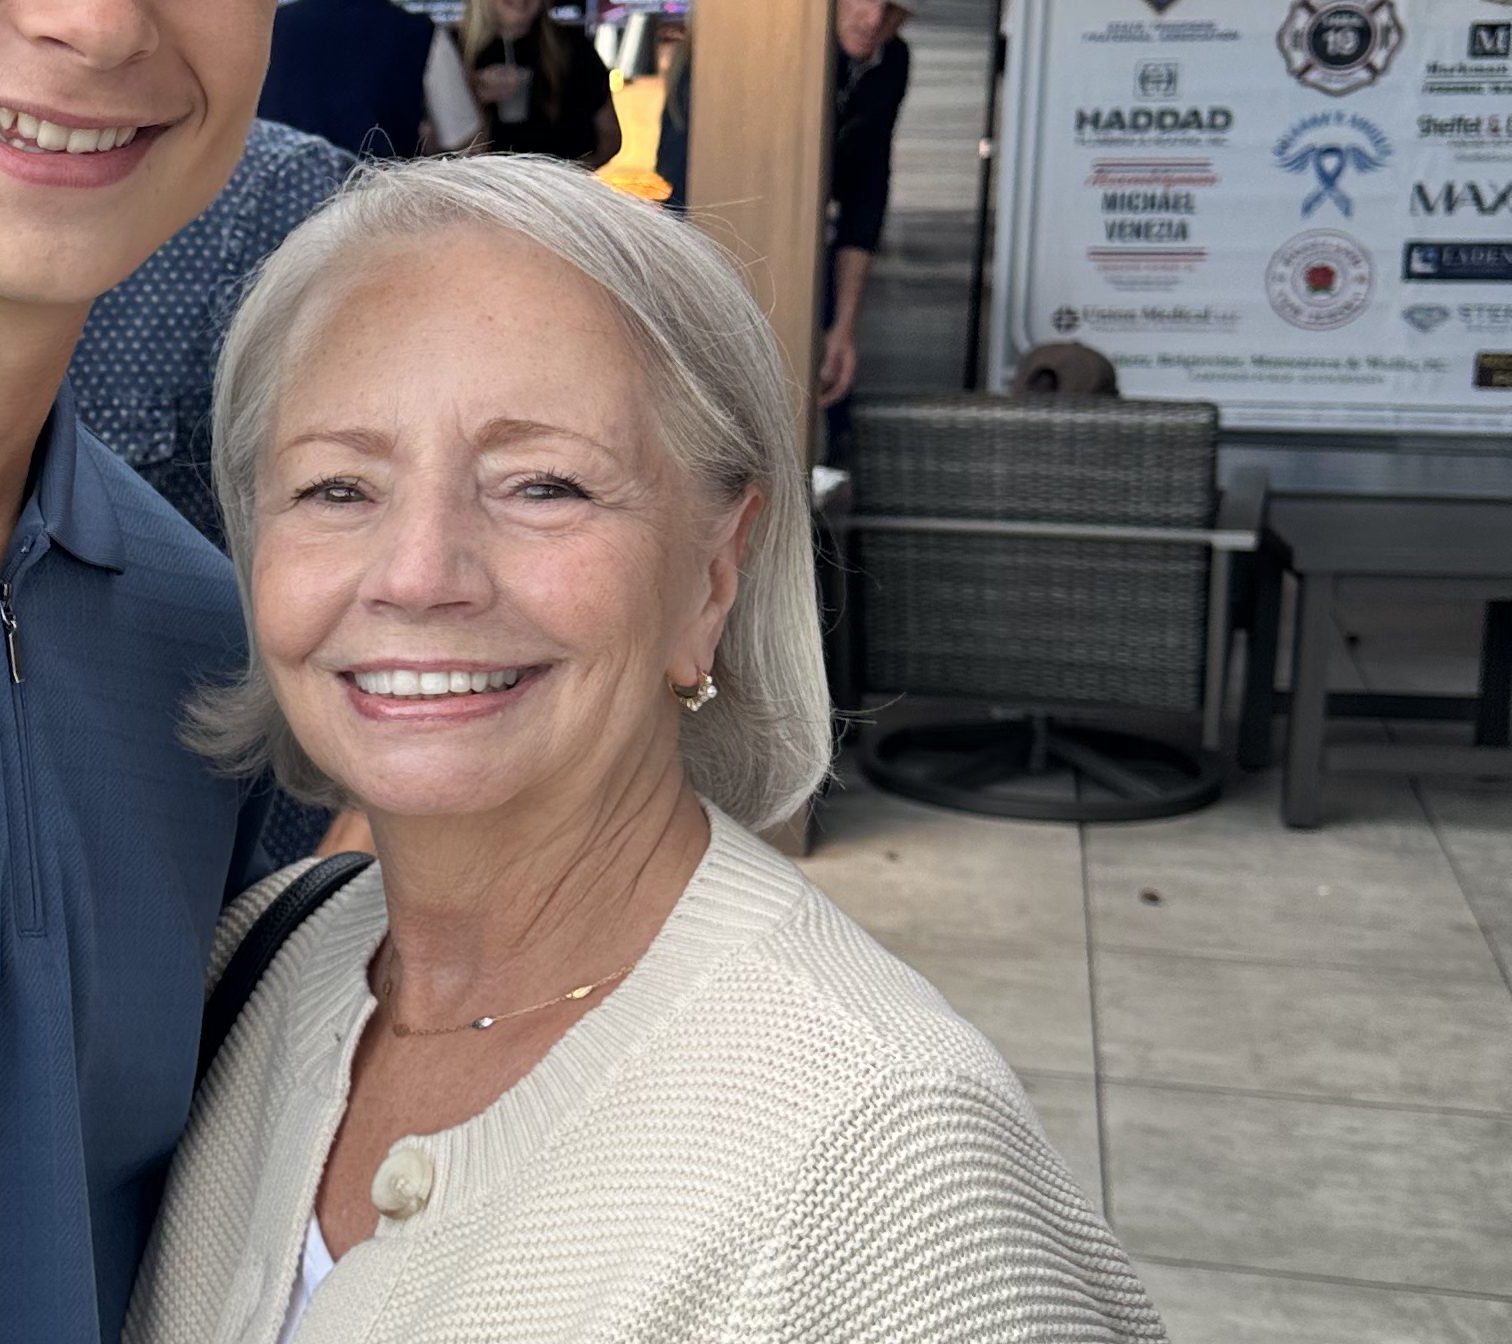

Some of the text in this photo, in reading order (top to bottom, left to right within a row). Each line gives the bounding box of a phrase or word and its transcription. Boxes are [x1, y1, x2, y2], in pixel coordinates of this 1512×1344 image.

[1074, 106, 1234, 133] HADDAD
[1100, 191, 1196, 215] MICHAEL
[1104, 219, 1189, 242] VENEZIA
